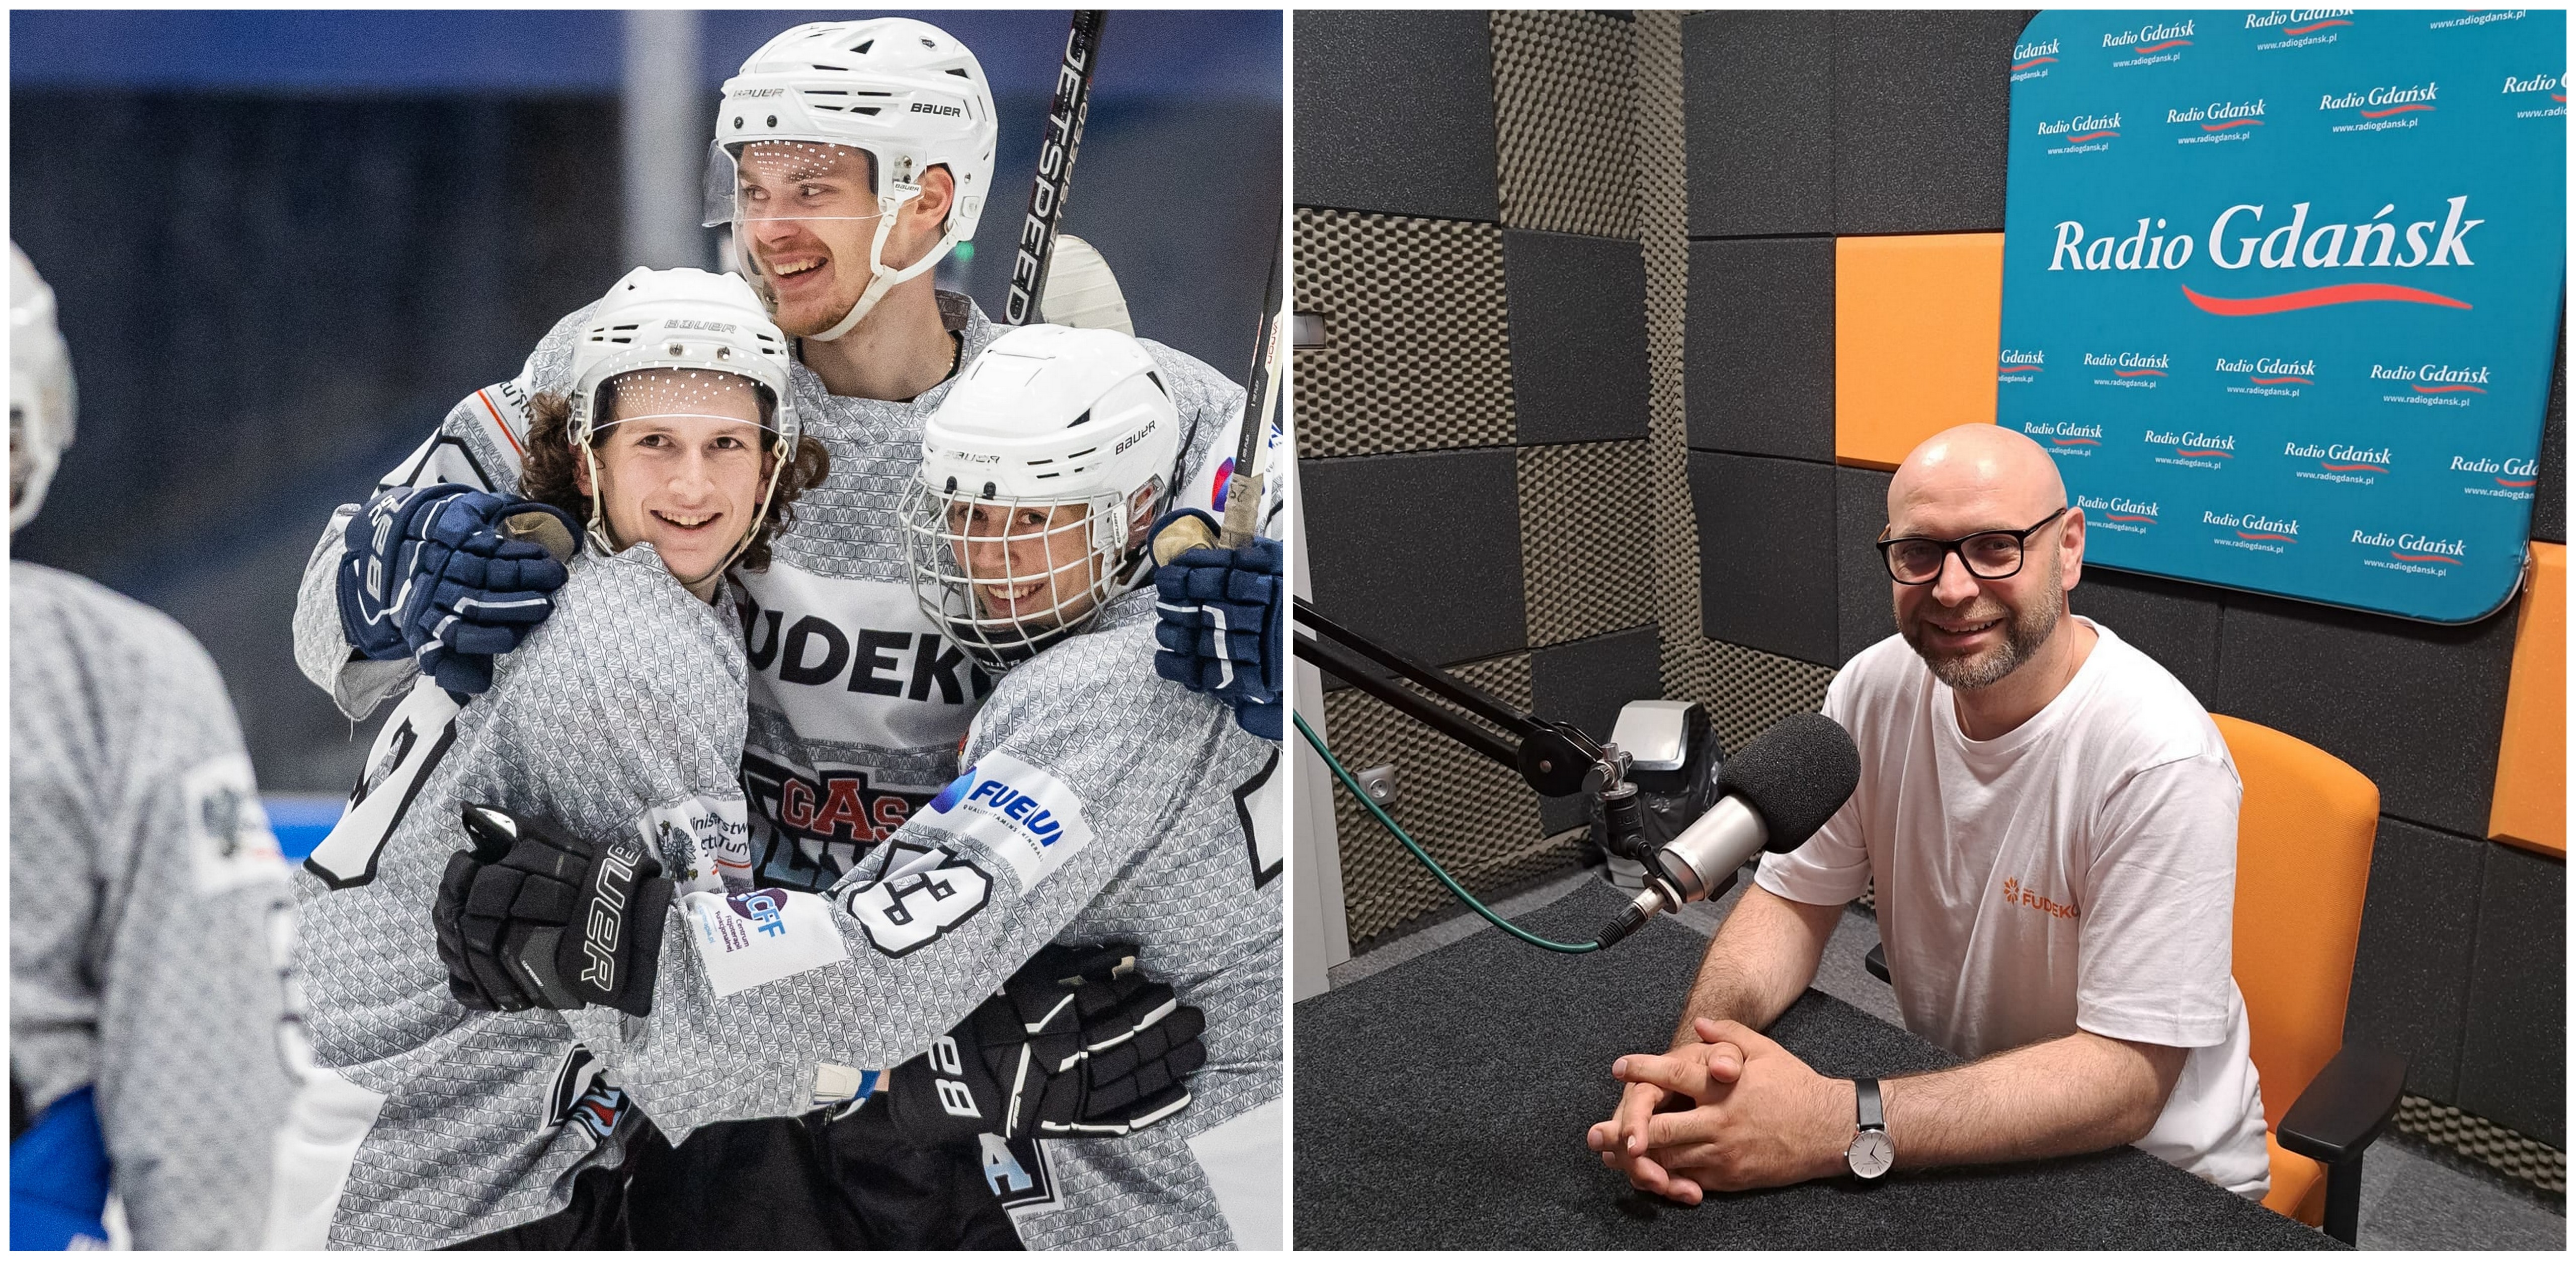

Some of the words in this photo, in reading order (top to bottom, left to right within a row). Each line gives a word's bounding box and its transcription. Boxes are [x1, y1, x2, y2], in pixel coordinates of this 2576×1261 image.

[2244, 11, 2287, 29] Radio
[2430, 9, 2526, 29] www.radiogdansk.pl
[2102, 31, 2138, 47] Radio
[2140, 19, 2195, 42] Gdańsk
[2257, 33, 2337, 50] www.radiogdansk.pl
[2013, 38, 2060, 60] Gdańsk
[2113, 53, 2180, 67] www.radiogdansk.pl
[2502, 74, 2556, 94] Radio
[2319, 93, 2365, 110] Radio
[2368, 82, 2438, 106] Gdańsk
[910, 103, 960, 117] BAUER
[2166, 107, 2205, 123] Radio
[2207, 99, 2266, 120] Gdańsk
[2038, 120, 2070, 135] Radio
[2072, 112, 2122, 131] Gdańsk
[2332, 118, 2418, 132] www.radiogdansk.pl
[2178, 131, 2249, 144] www.radiogdansk.pl
[2048, 142, 2109, 154] www.radiogdansk.pl
[1006, 28, 1086, 326] JETSPEED
[895, 183, 920, 192] BAUER
[2047, 217, 2194, 271] Radio
[2208, 195, 2485, 269] Gdańsk
[664, 319, 737, 334] BAUER
[2001, 349, 2045, 364] Gdańsk
[2083, 353, 2117, 366] Radio
[2119, 352, 2169, 368] Gdańsk
[2215, 358, 2254, 372] Radio
[2256, 358, 2316, 375] Gdańsk
[2370, 364, 2416, 380] Radio
[2419, 364, 2490, 383] Gdańsk
[2094, 379, 2156, 389] www.radiogdansk.pl
[2227, 387, 2299, 398] www.radiogdansk.pl
[2383, 396, 2469, 407] www.radiogdansk.pl
[1115, 420, 1156, 455] BAUER
[2024, 422, 2055, 435] Radio
[2056, 422, 2103, 438] Gdańsk
[2144, 430, 2180, 445] Radio
[2182, 431, 2235, 450] Gdańsk
[2284, 442, 2325, 458] Radio
[2328, 444, 2391, 464] Gdańsk
[2155, 457, 2221, 470] www.radiogdansk.pl
[2450, 456, 2500, 473] Radio
[2296, 472, 2374, 486] www.radiogdansk.pl
[2077, 495, 2109, 510] Radio
[2110, 497, 2159, 516] Gdańsk
[2087, 521, 2146, 534] www.radiogdansk.pl
[2203, 511, 2240, 527] Radio
[2242, 514, 2299, 535] Gdańsk
[2214, 539, 2284, 554] www.radiogdansk.pl
[2351, 529, 2395, 547] Radio
[2398, 533, 2466, 556] Gdańsk
[2364, 560, 2446, 577] www.radiogdansk.pl
[746, 895, 786, 938] CFF
[714, 910, 735, 953] Funkcjonalnej
[726, 914, 743, 950] Fizjoterapii
[736, 919, 750, 947] Centrum
